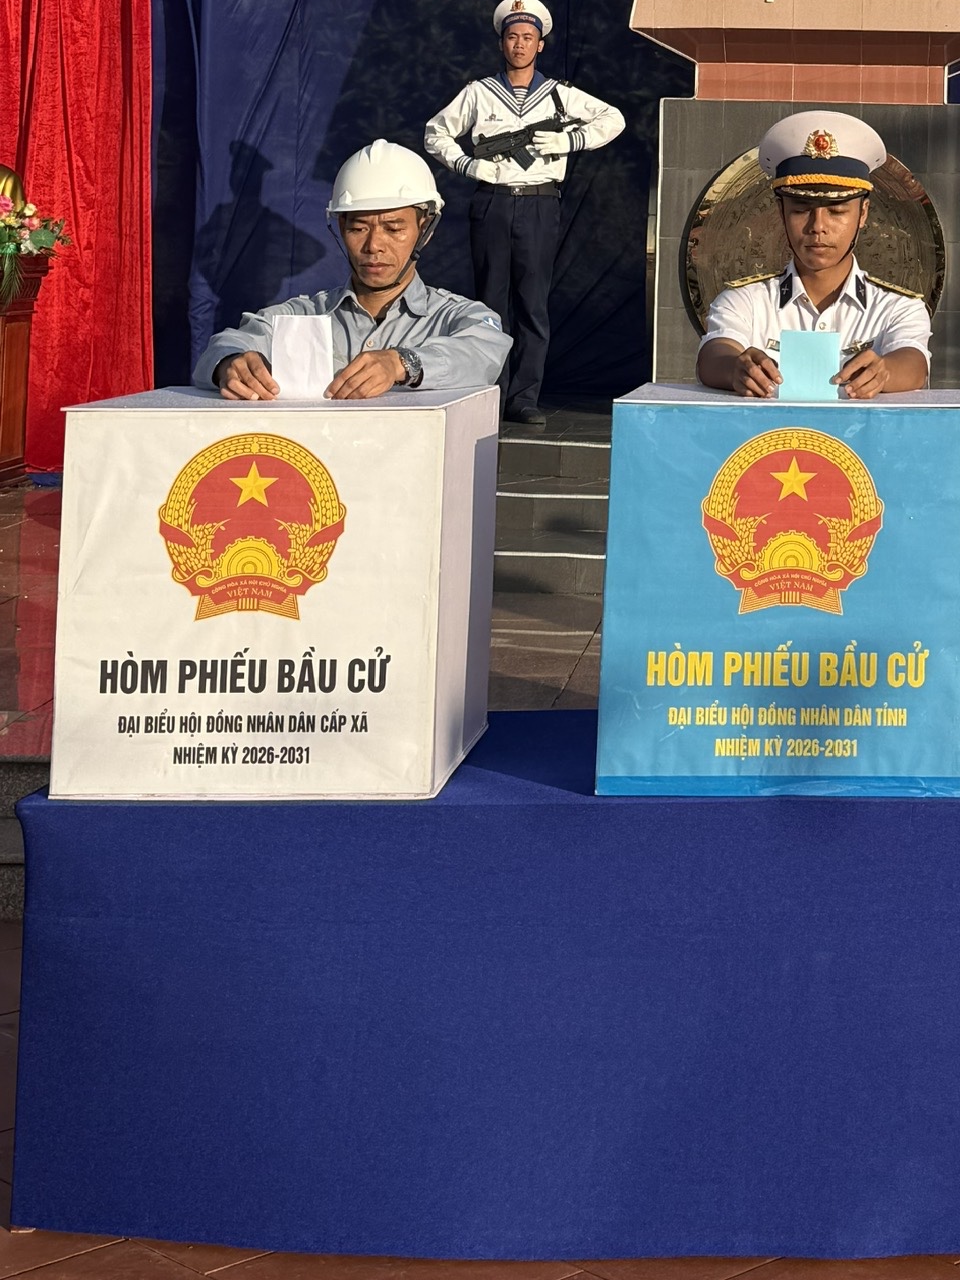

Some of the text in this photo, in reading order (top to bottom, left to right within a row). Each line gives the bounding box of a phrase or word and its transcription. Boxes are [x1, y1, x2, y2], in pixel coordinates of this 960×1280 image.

[227, 587, 272, 597] VIỆT NAM
[769, 580, 813, 591] VIỆT NAM
[99, 646, 391, 694] HÒM PHIẾU BẦU CỬ
[646, 640, 929, 688] HÒM PHIẾU BẦU CỬ
[118, 708, 368, 738] ĐẠI BIỂU HỘI ĐỒNG NHÂN DÂN CẤP XÃ
[668, 700, 907, 729] ĐẠI BIỂU HỘI ĐỒNG NHÂN DÂN TỈNH
[172, 742, 310, 768] NHIỆM KỲ 2026-2031
[714, 734, 858, 760] NHIỆM KỲ 2026-2031
